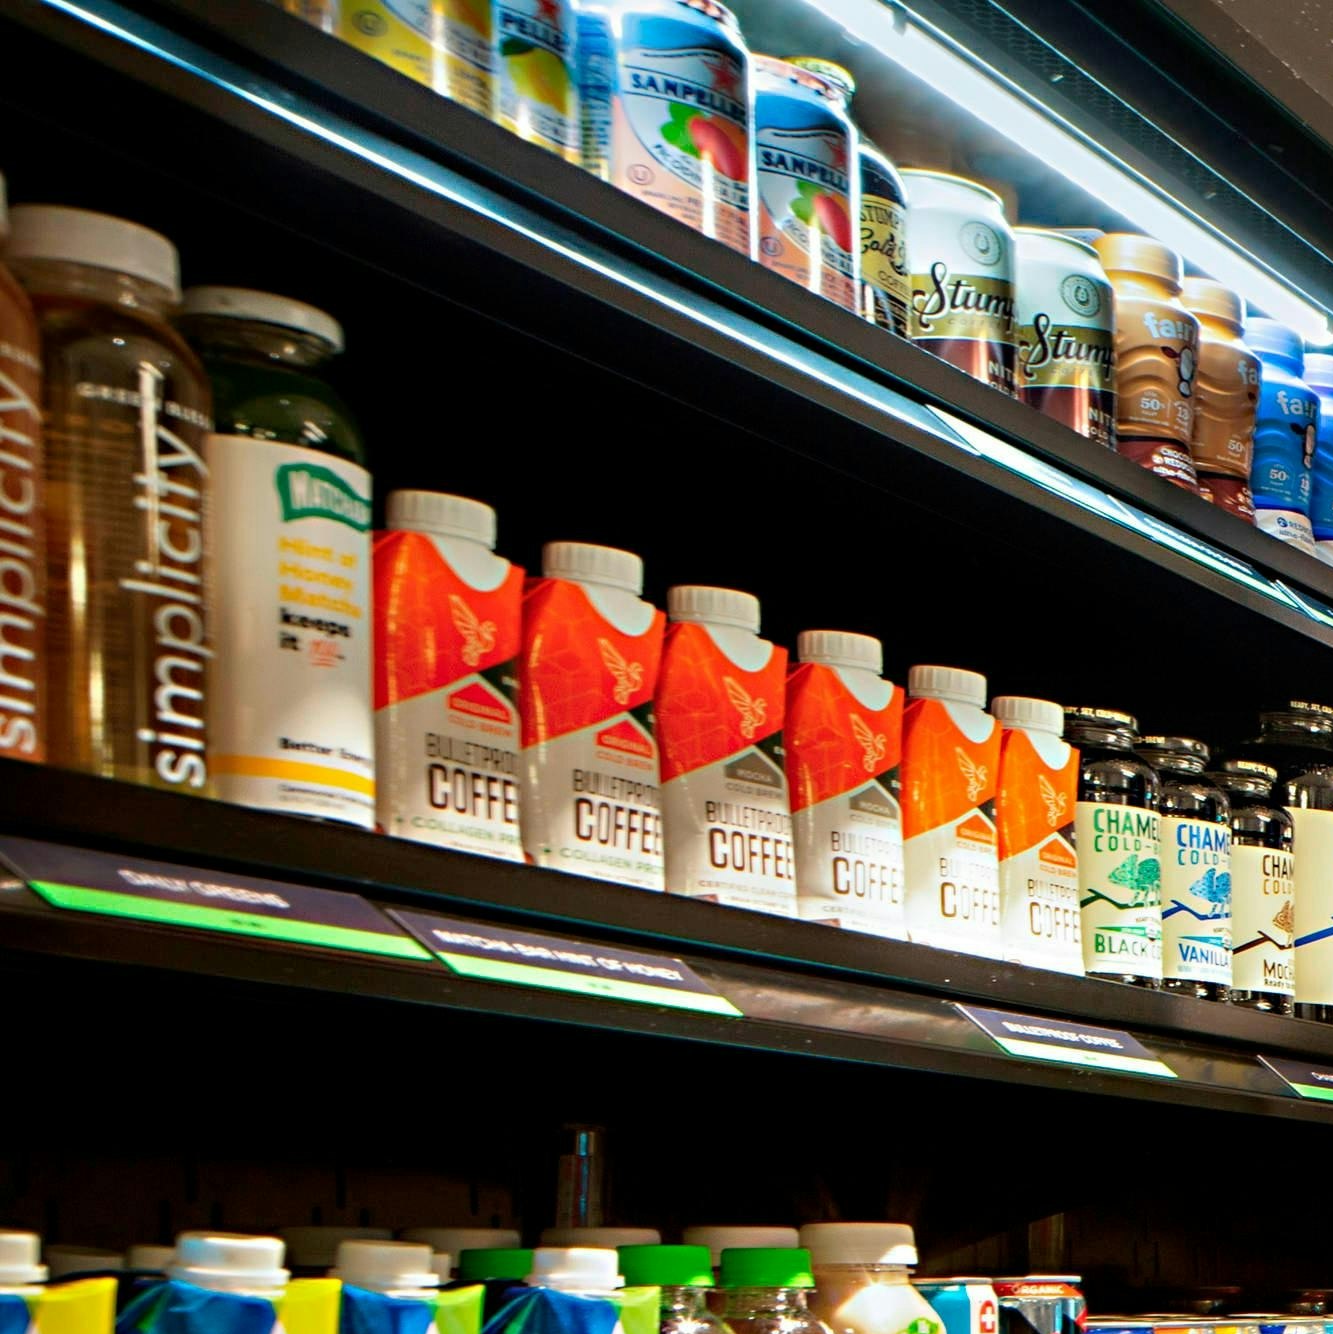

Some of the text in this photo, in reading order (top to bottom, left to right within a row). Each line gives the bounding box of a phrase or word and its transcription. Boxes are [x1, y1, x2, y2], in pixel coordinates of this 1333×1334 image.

[120, 423, 215, 789] simplicity
[279, 606, 351, 639] keeps
[1095, 934, 1148, 957] BLACK
